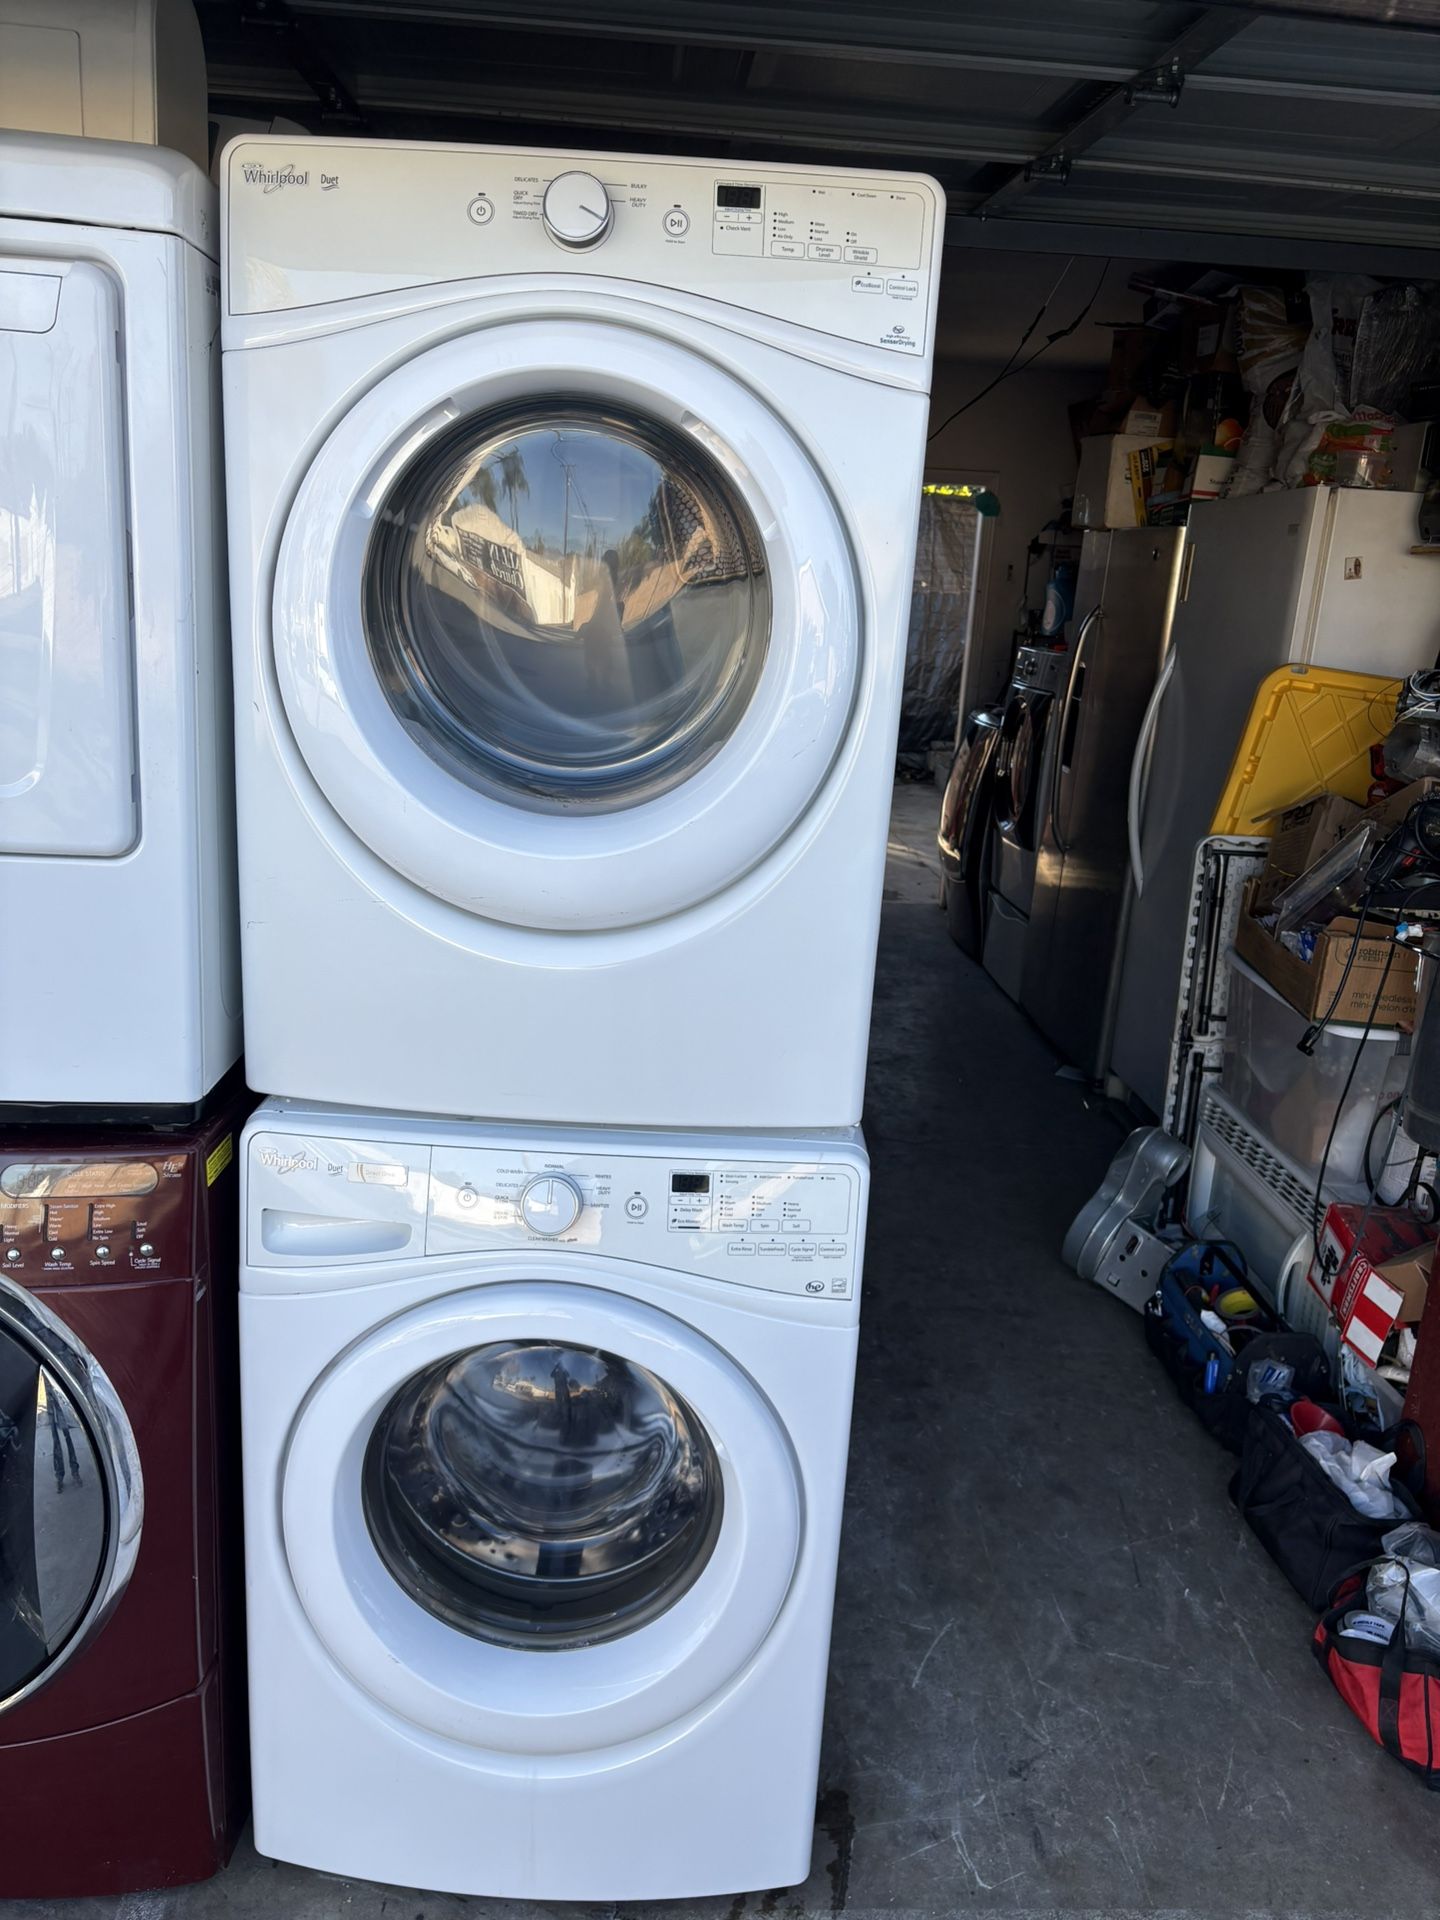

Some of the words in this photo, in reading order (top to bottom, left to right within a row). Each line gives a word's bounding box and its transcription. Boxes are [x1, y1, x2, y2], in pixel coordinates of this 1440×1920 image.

[243, 167, 308, 188] Whirlpool
[320, 173, 340, 188] Duet
[879, 337, 916, 347] SensorDrying
[1352, 991, 1371, 1000] mini
[259, 1152, 319, 1172] Whirlpool
[327, 1162, 344, 1175] Duet
[12, 1261, 25, 1269] Level
[89, 1259, 101, 1267] Spin
[101, 1258, 116, 1266] Speed
[147, 1256, 162, 1264] Signal
